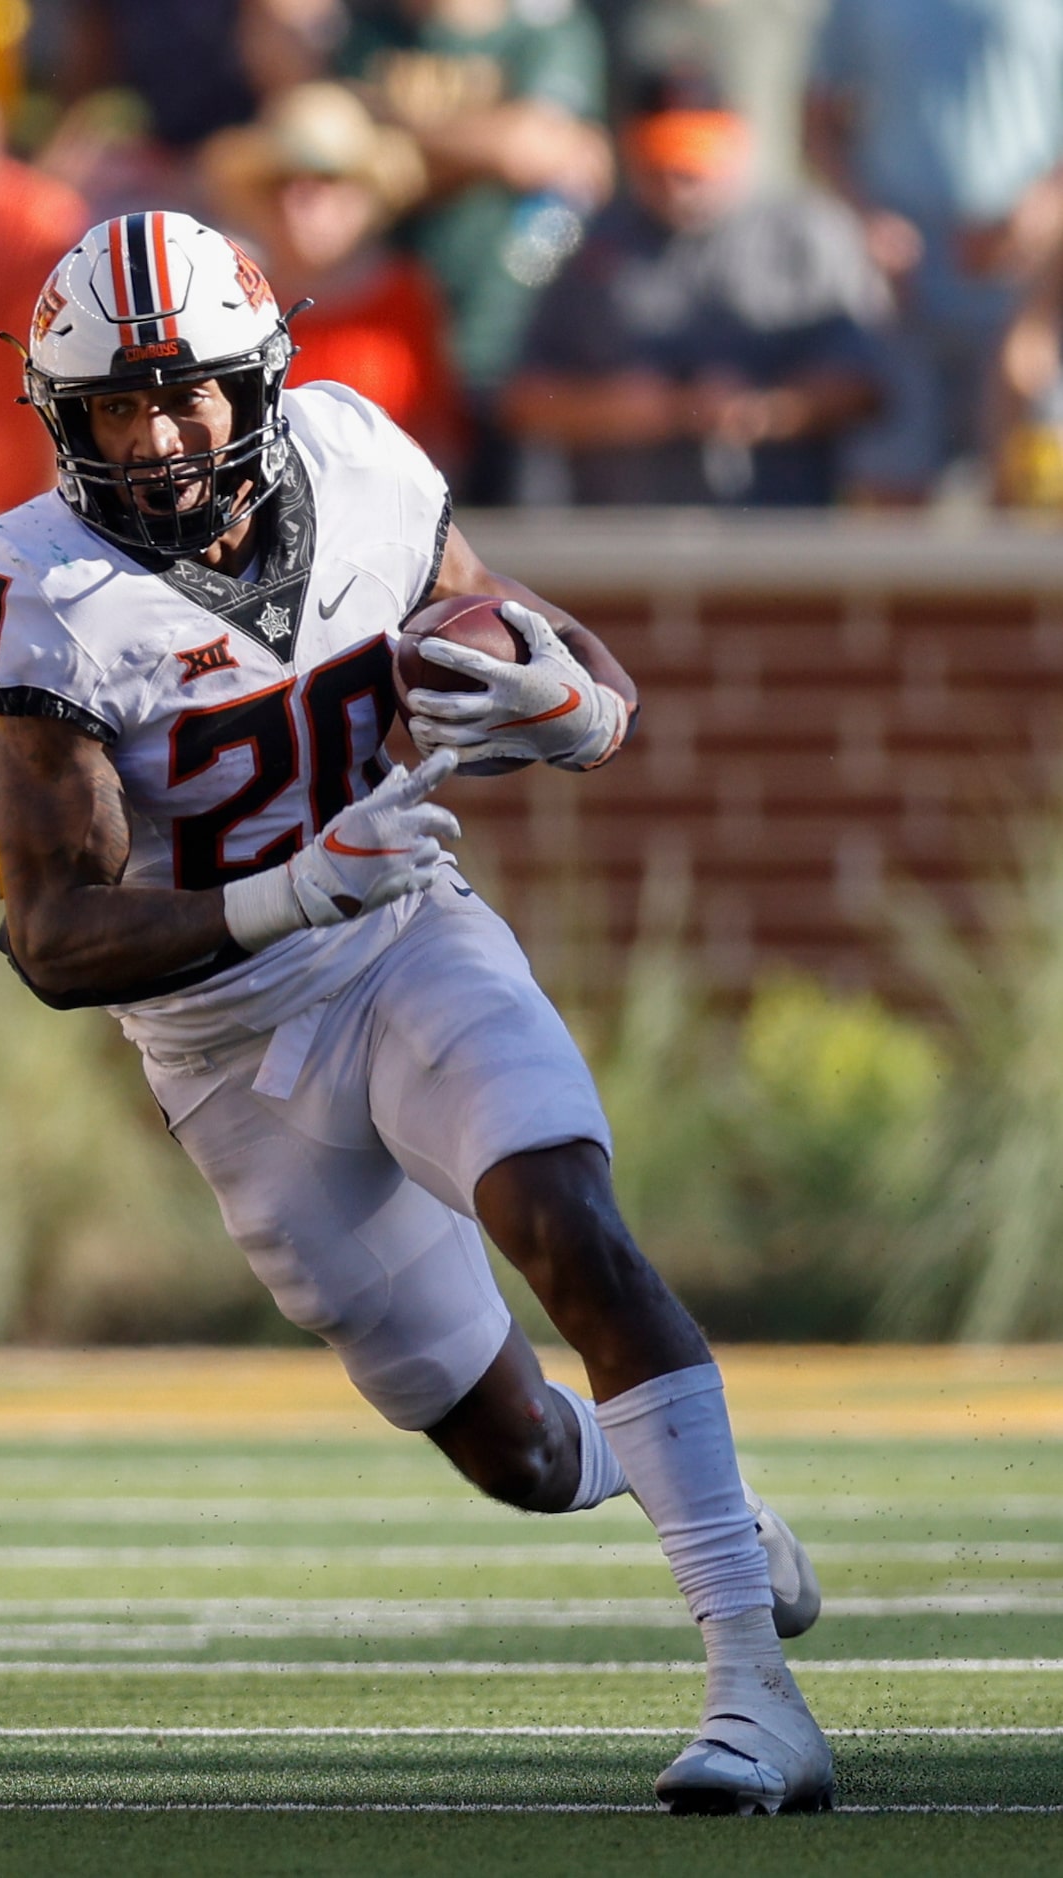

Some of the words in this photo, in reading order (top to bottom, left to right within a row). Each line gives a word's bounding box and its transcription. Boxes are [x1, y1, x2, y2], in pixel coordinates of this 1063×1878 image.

[124, 341, 179, 363] COWBOYS
[173, 632, 240, 685] XII
[167, 629, 401, 892] 20
